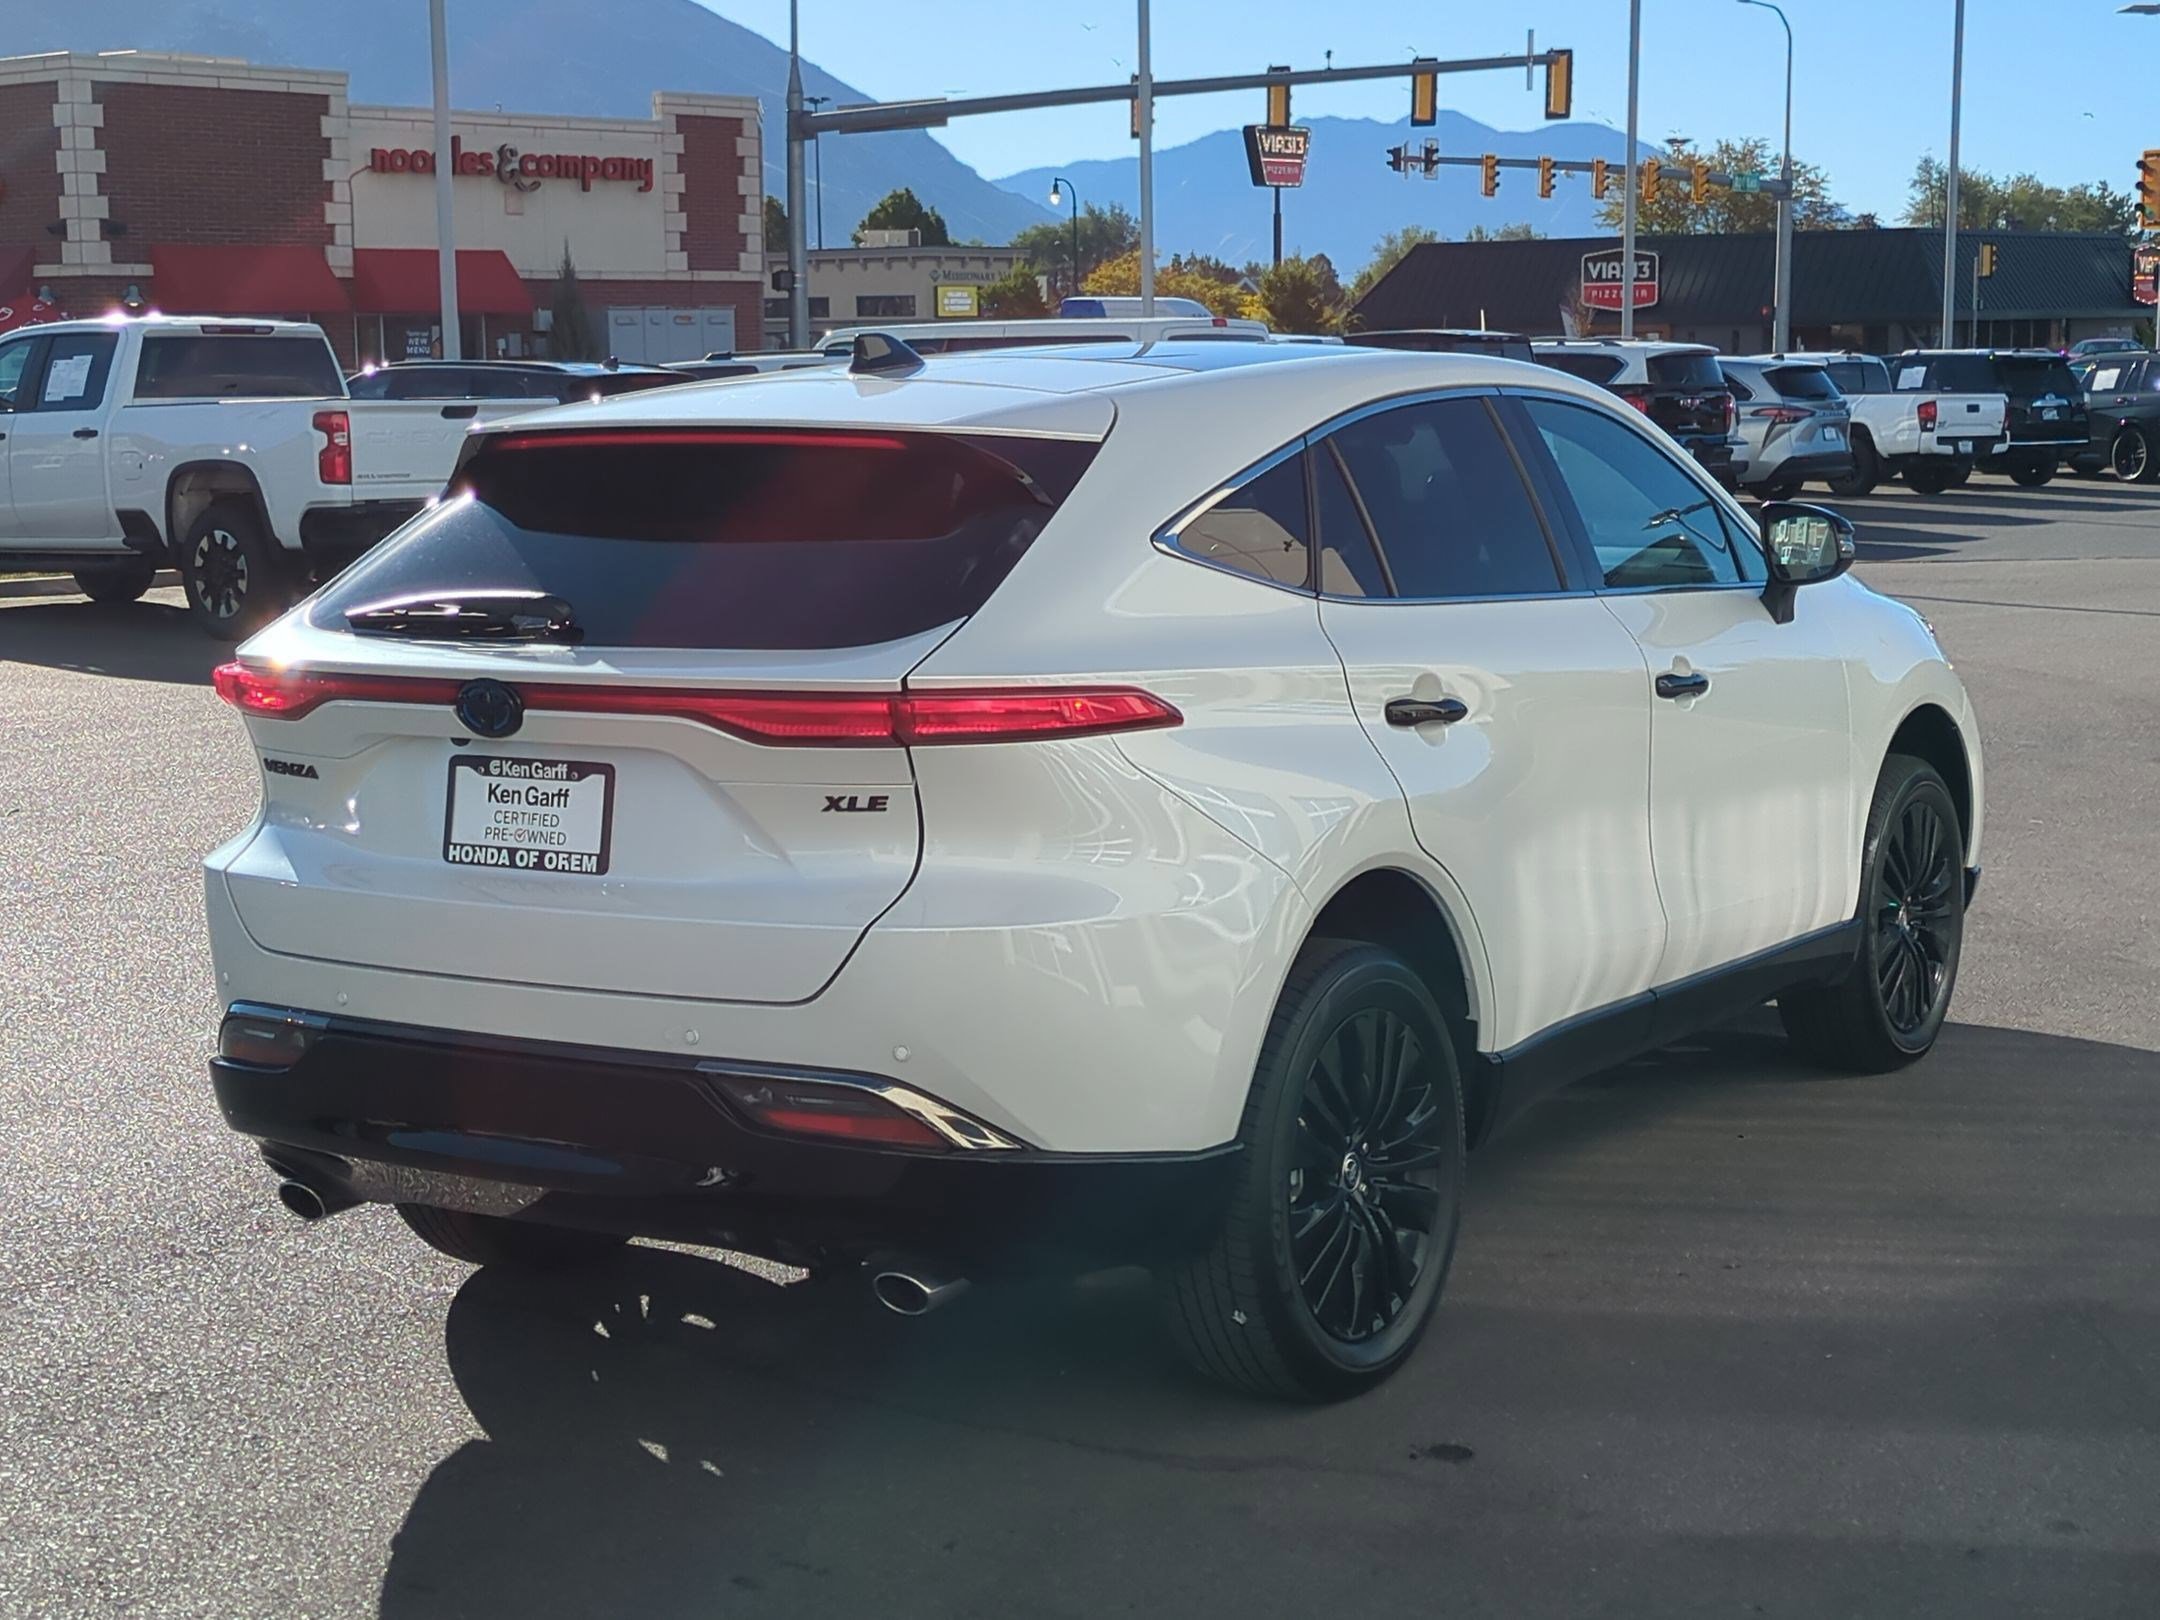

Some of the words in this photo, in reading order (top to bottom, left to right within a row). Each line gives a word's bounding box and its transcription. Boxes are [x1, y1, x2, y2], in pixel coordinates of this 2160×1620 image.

[1261, 134, 1304, 154] VIA313
[371, 135, 494, 177] nooles
[519, 153, 654, 192] company
[1591, 289, 1648, 299] PIZZIA
[263, 758, 319, 779] VENZA
[502, 760, 530, 778] Ken
[531, 762, 568, 780] Garff
[488, 782, 521, 805] Ken
[525, 786, 570, 808] Garff
[821, 795, 889, 812] XLE
[494, 810, 560, 828] CERTIFIED
[448, 845, 510, 866] HONDA
[515, 850, 540, 868] OF
[543, 853, 597, 873] OREM
